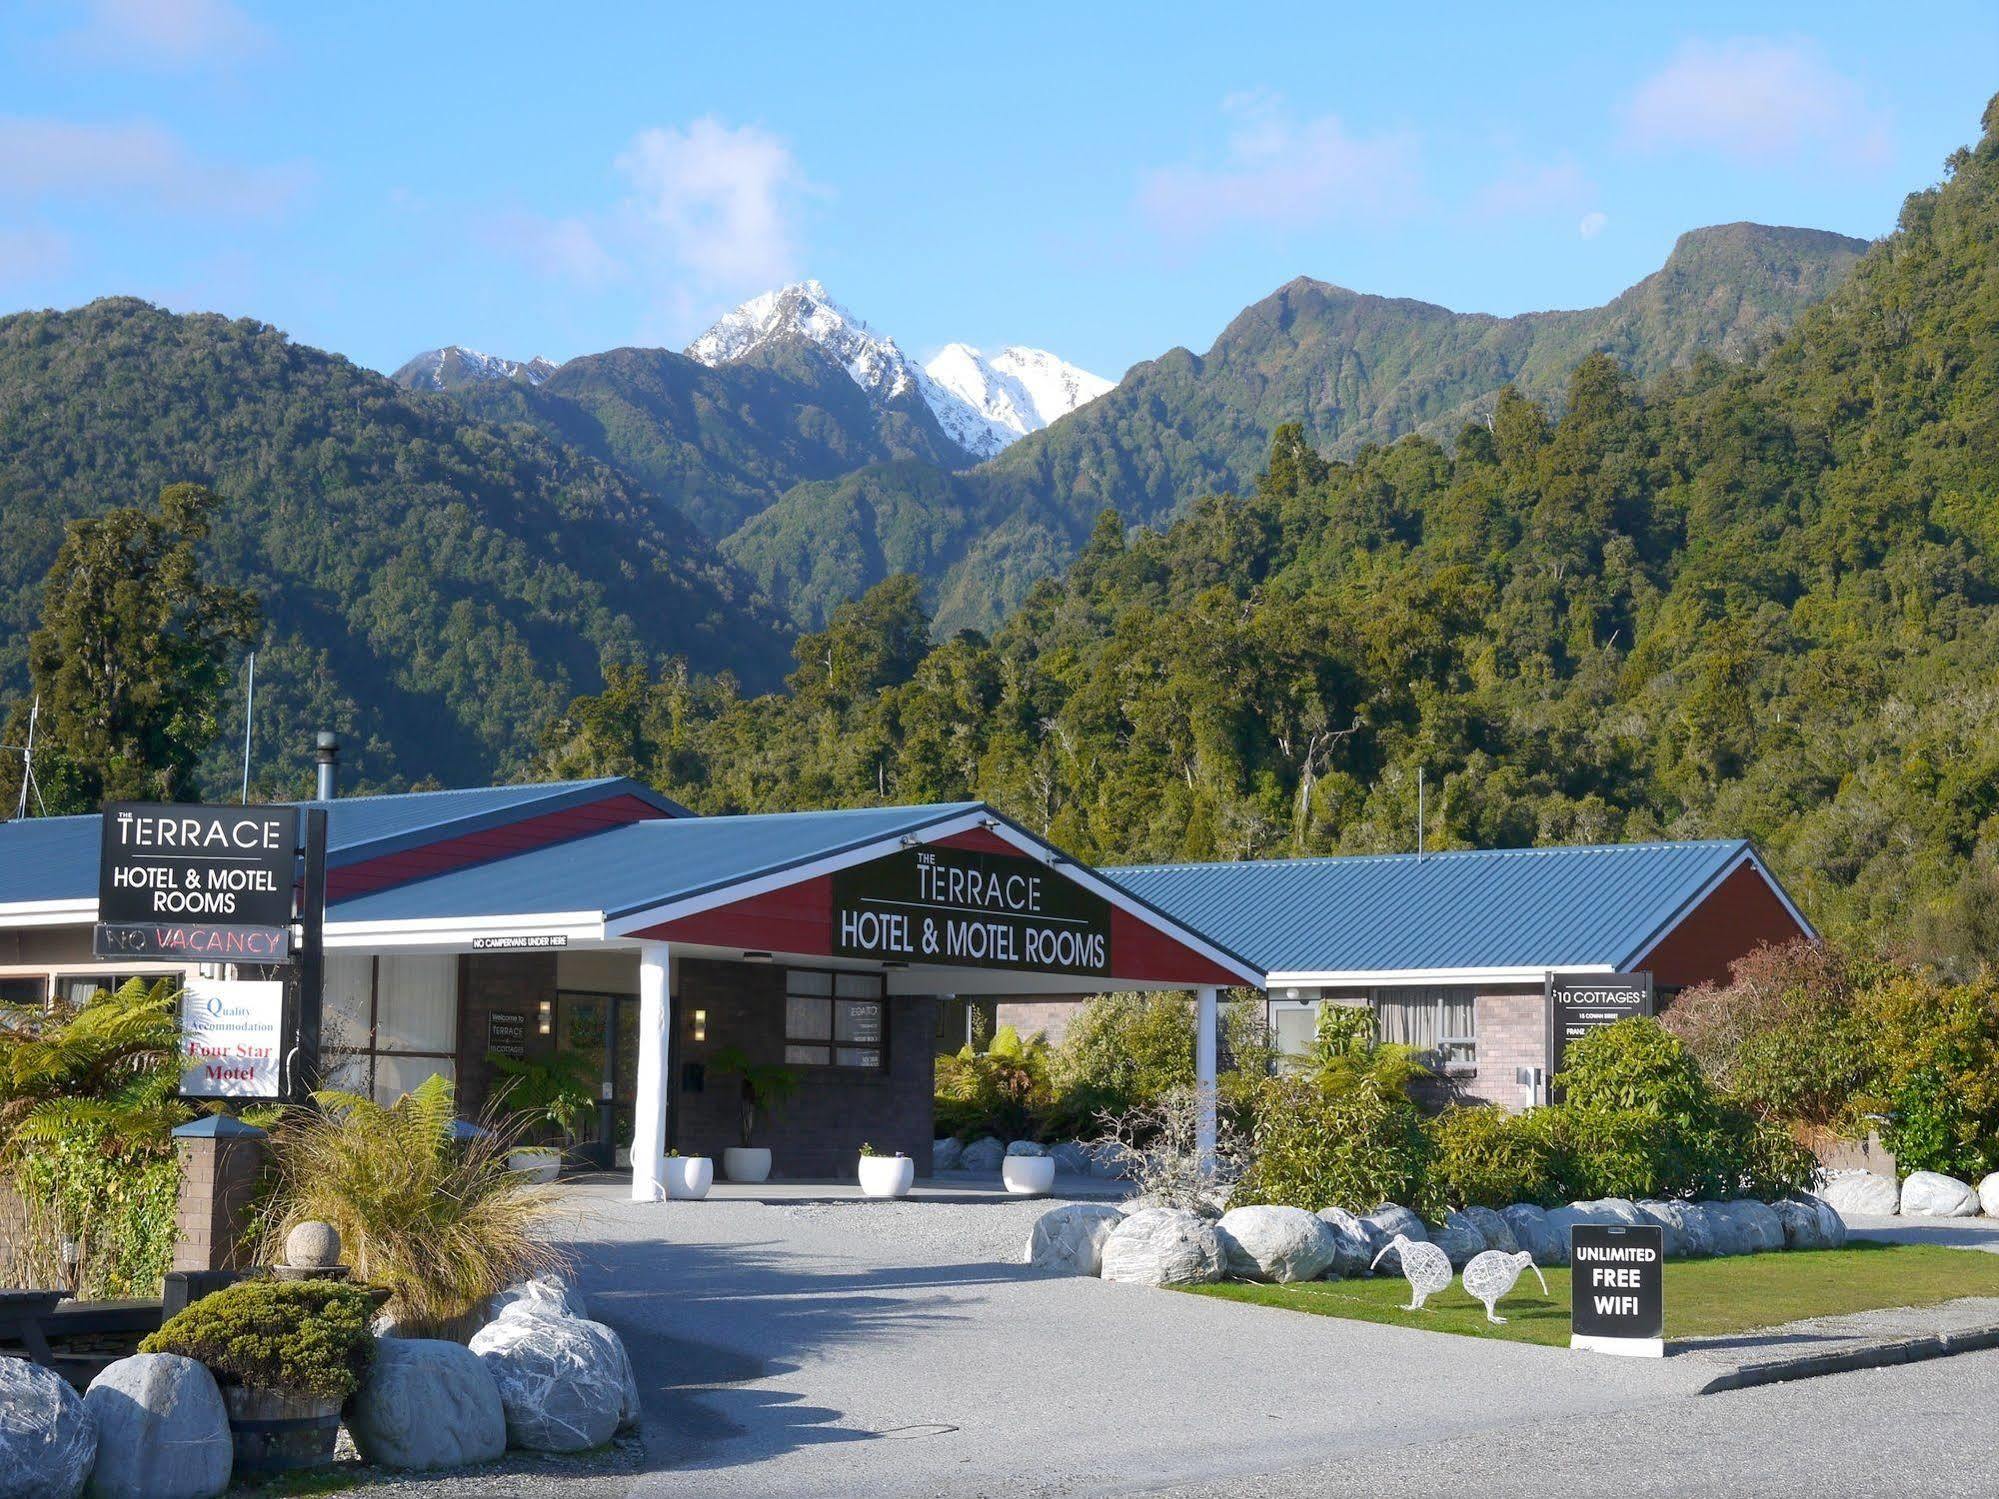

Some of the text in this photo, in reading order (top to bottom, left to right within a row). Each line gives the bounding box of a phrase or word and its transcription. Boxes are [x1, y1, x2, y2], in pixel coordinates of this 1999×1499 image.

[117, 818, 280, 849] TERRACE
[918, 853, 935, 865] THE
[113, 866, 277, 892] HOTEL & MOTEL
[917, 864, 1041, 911] TERRACE
[153, 891, 236, 914] ROOMS
[105, 927, 281, 954] NO VACANCY
[473, 936, 567, 948] NO CAMPERVANS UNDER HERE
[841, 909, 1105, 969] HOTEL & MOTEL ROOMS
[1557, 991, 1640, 1003] 10 COTTAGES
[191, 1021, 274, 1032] Accommodation
[188, 1041, 273, 1058] Four Star
[205, 1065, 256, 1080] Motel
[1576, 1246, 1656, 1262] UNLIMITED
[1592, 1268, 1641, 1288] FREE
[1593, 1295, 1639, 1316] WIFI
